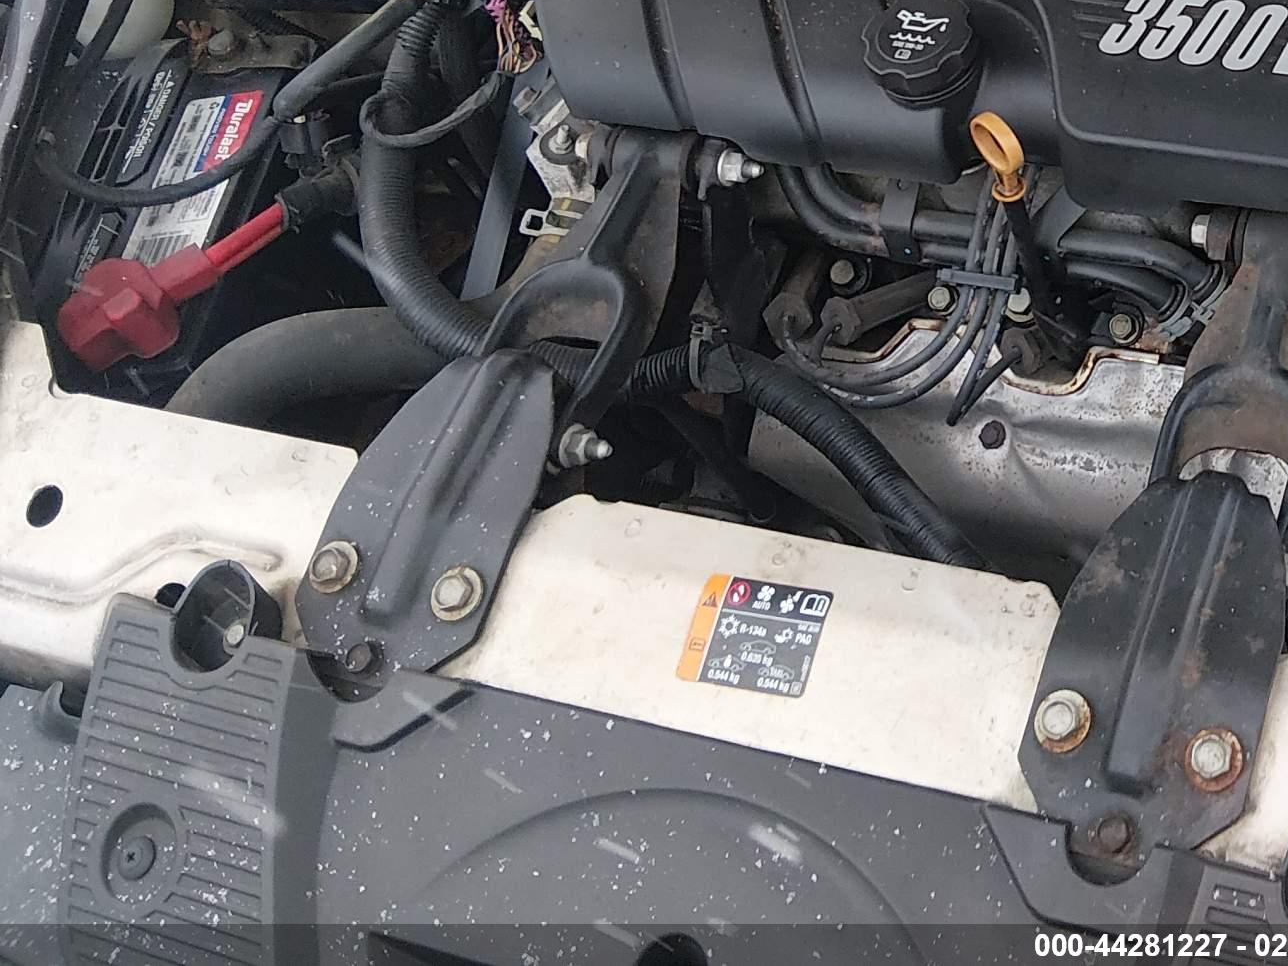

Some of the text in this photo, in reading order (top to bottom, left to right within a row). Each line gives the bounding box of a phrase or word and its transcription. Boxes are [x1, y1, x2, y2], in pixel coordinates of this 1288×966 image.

[151, 89, 172, 121] DANGER
[214, 98, 254, 161] Duralast
[752, 601, 771, 611] AUTO
[739, 623, 767, 637] R-134a
[795, 632, 812, 645] PAG
[763, 656, 774, 667] kg
[728, 673, 740, 685] kg
[779, 682, 790, 694] kg
